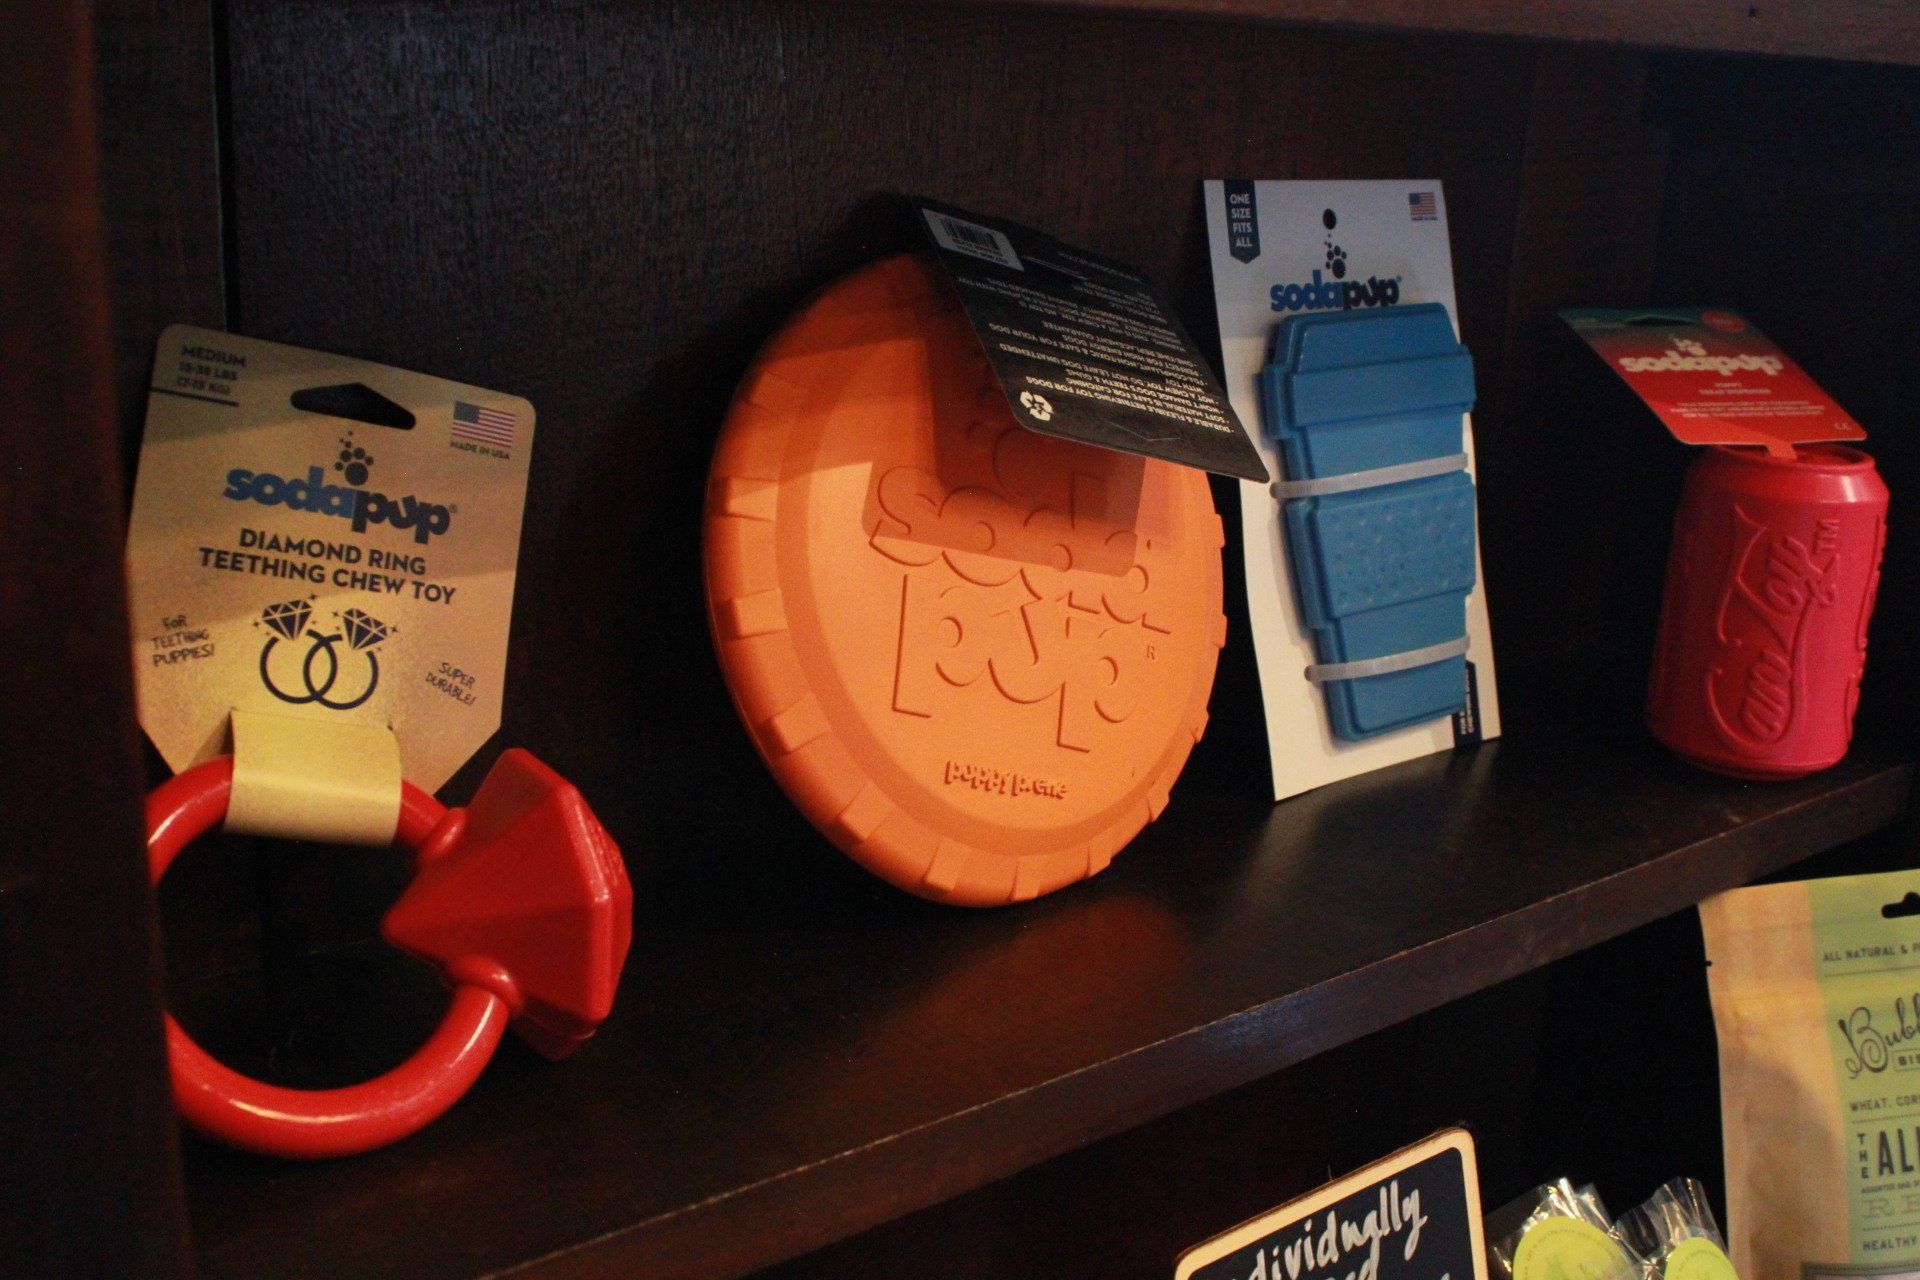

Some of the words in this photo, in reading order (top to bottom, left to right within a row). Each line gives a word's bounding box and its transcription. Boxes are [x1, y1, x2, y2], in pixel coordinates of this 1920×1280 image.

[1230, 193, 1250, 205] ONE
[1231, 208, 1251, 219] SIZE
[1233, 222, 1252, 233] FITS
[1235, 236, 1252, 248] ALL
[1270, 269, 1400, 312] sodapup
[181, 345, 246, 369] MEDIUM
[1618, 349, 1784, 376] sodapup
[1024, 375, 1054, 389] DOGS
[450, 440, 479, 453] MADE
[480, 446, 492, 456] IN
[493, 448, 511, 461] USA
[223, 466, 451, 544] sodapup
[238, 528, 361, 565] DIAMOND
[367, 549, 425, 576] RING
[199, 547, 325, 584] TEETHING
[332, 568, 404, 595] CHEW
[411, 580, 456, 605] TOY
[438, 661, 475, 688] SUPER
[890, 572, 1136, 754] pup
[425, 671, 477, 706] DURABLE!
[1823, 952, 1841, 962] ALL
[1846, 946, 1895, 959] NATURAL
[1857, 1133, 1869, 1179] THE
[1231, 1179, 1428, 1280] dividually
[1863, 1235, 1917, 1250] HEALTHY
